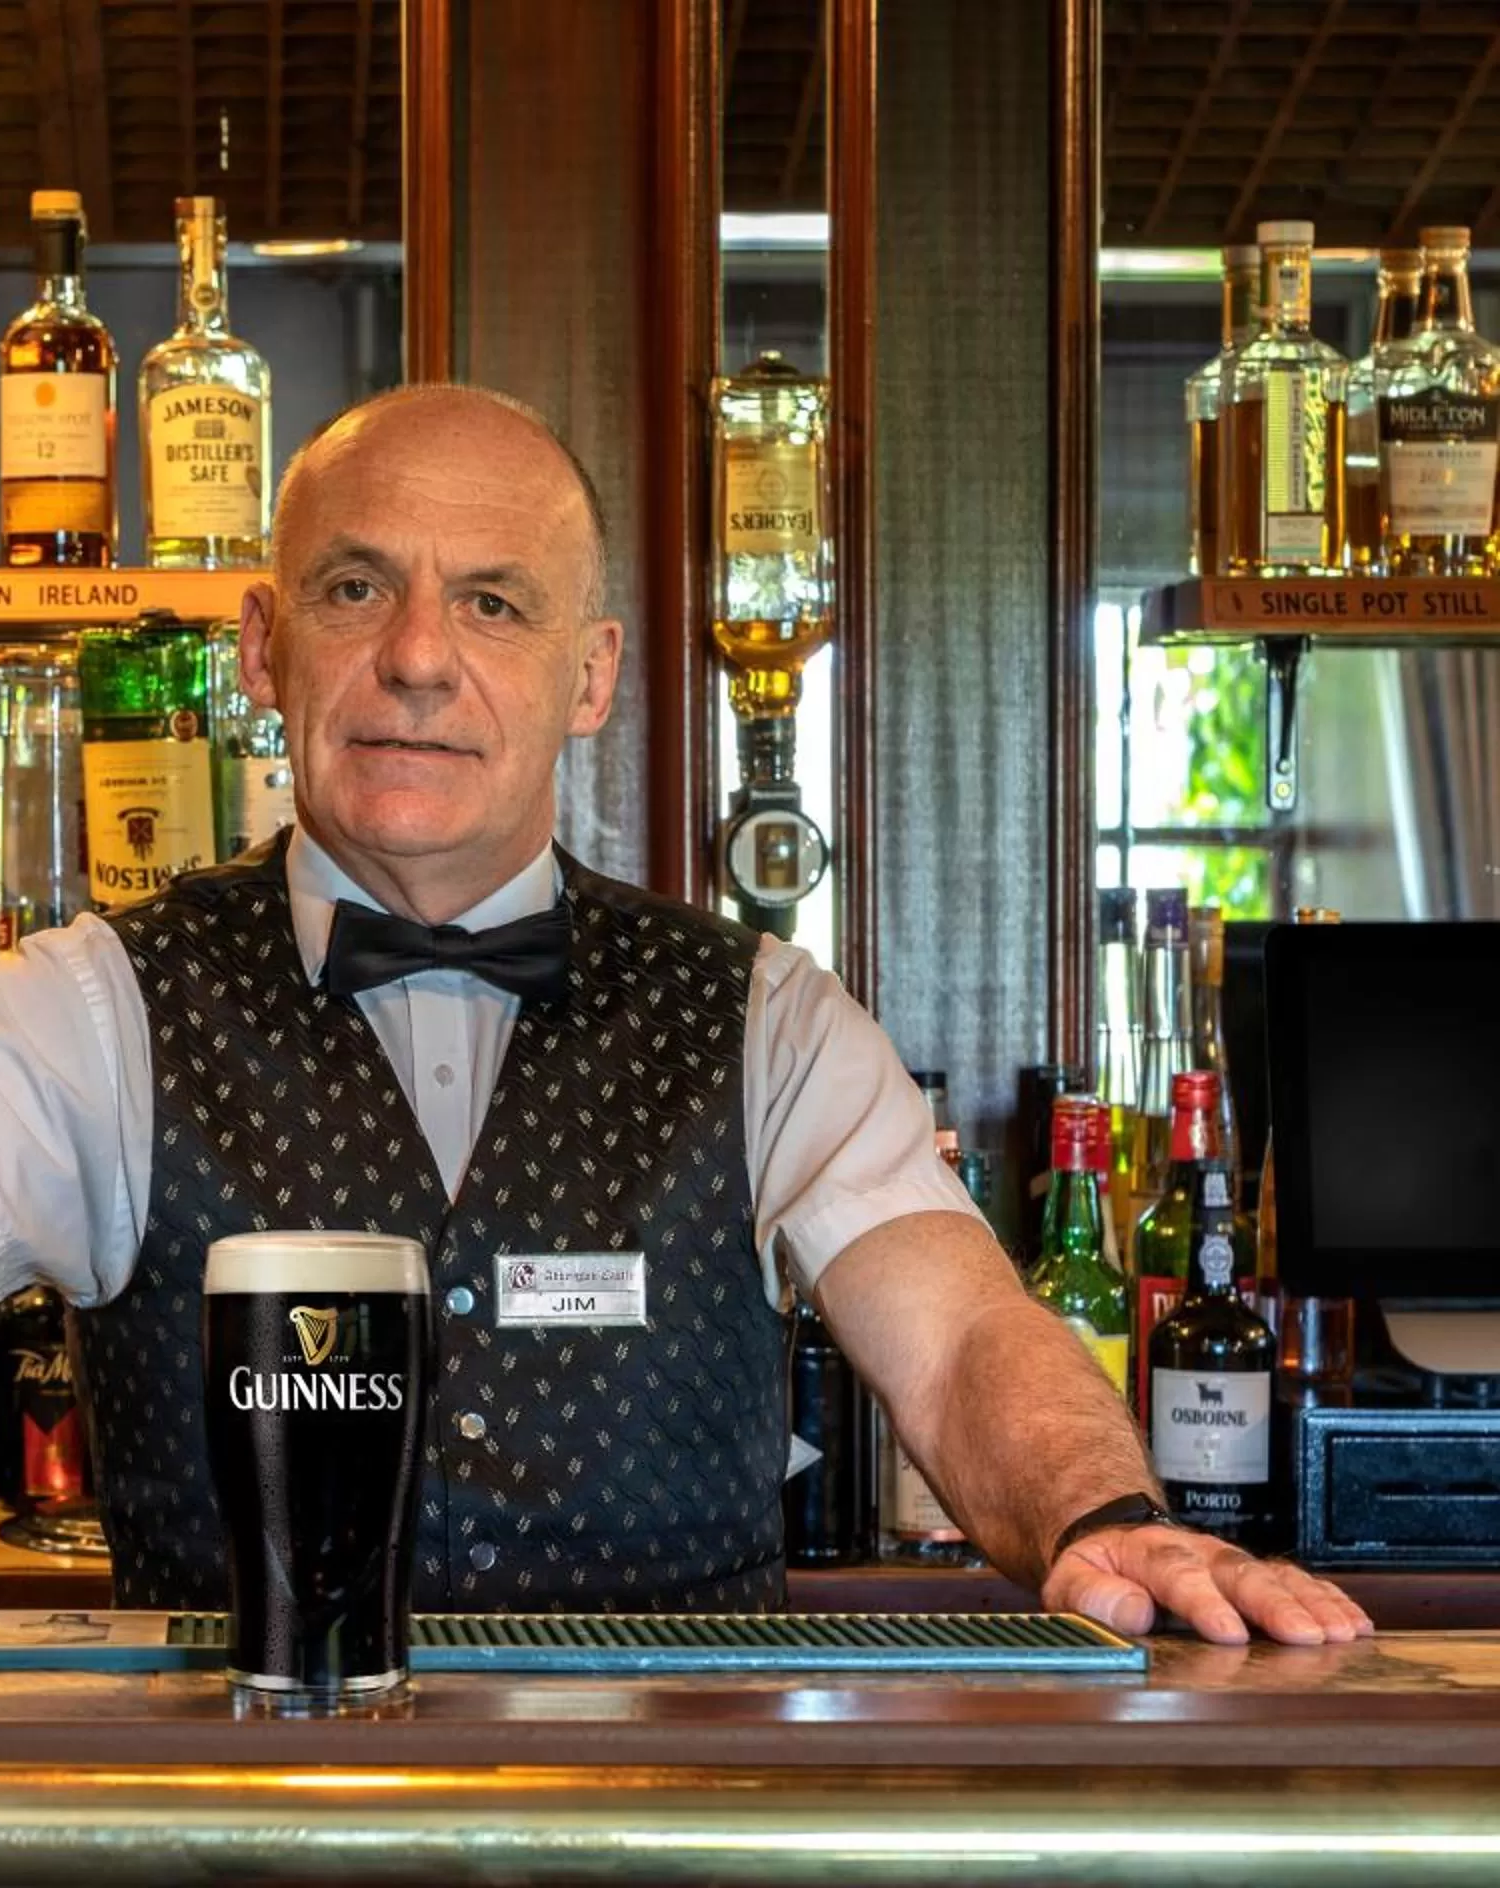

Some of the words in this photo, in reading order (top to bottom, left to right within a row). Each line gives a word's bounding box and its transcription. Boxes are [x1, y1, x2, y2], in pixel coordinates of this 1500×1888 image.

[163, 396, 255, 423] JAMESON
[1390, 404, 1486, 425] MIDLETON
[37, 440, 55, 459] 12
[166, 443, 255, 463] DISTILLER'S
[189, 463, 229, 483] SAFE
[39, 583, 138, 606] IRELAND
[1261, 591, 1348, 615] SINGLE
[1363, 591, 1408, 615] POT
[1424, 591, 1488, 615] STILL
[551, 1297, 595, 1312] JIM
[229, 1365, 404, 1411] GUINNESS
[1171, 1406, 1248, 1428] OSBORNE
[1185, 1489, 1241, 1510] PORTO
